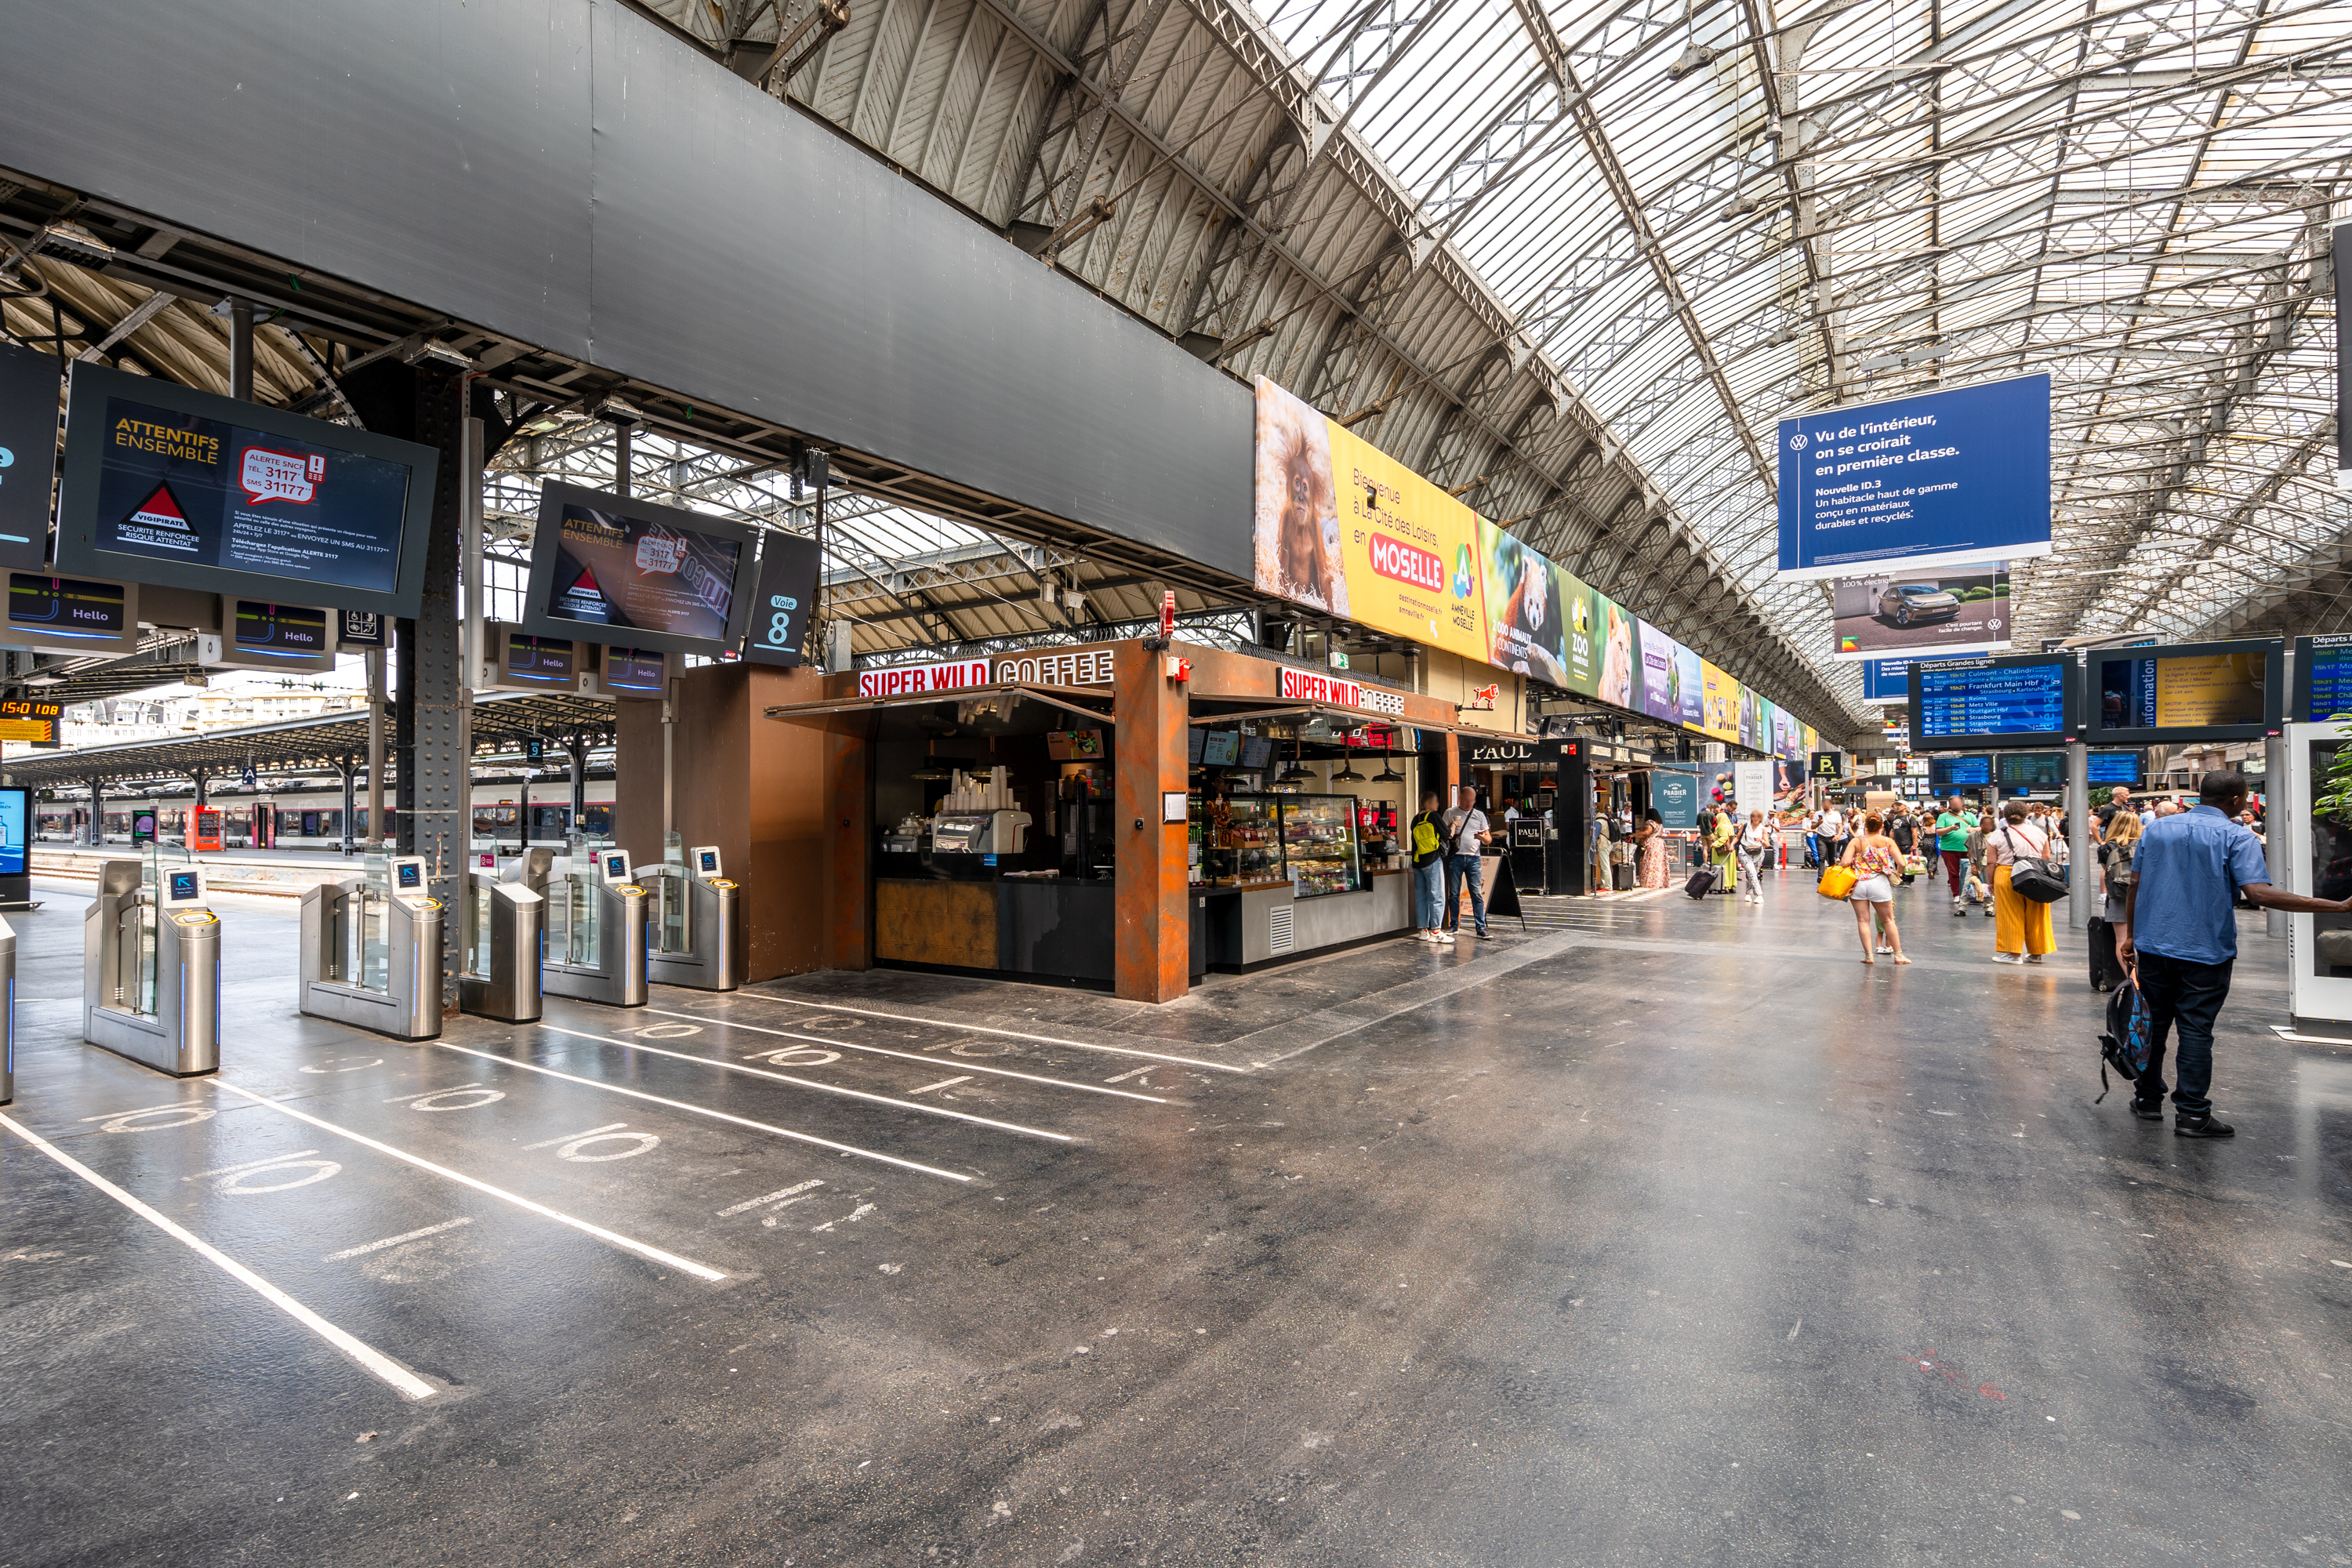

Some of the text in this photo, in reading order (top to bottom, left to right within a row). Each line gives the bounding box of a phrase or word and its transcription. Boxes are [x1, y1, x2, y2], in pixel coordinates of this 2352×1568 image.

[116, 418, 220, 450] ATTENTIFS
[1816, 415, 1936, 442] Vu de l'intérieur,
[116, 432, 218, 464] ENSEMBLE
[1816, 435, 1911, 459] on se croirait
[248, 465, 263, 474] TÉL.
[249, 454, 304, 470] ALERTE SNCF
[1816, 447, 1960, 476] en première classe.
[1816, 480, 1882, 496] Nouvelle ID.3
[1816, 481, 1958, 508] Un habitacle haut de gamme
[1816, 510, 1842, 521] conçu
[1860, 500, 1910, 513] matériaux
[138, 514, 183, 527] VIGIPIRATE
[564, 518, 624, 538] ATTENTIFS
[1353, 495, 1439, 549] à La Cité des Loisirs,
[1816, 518, 1856, 530] durables
[1858, 516, 1868, 525] et
[118, 524, 199, 543] SECURITE RENFORCEE
[125, 532, 191, 547] RISQUE ATTENTAT
[234, 522, 263, 532] APPELEZ
[298, 533, 329, 544] ENVOYEZ
[563, 530, 622, 549] ENSEMBLE
[232, 538, 267, 547] Téléchargez
[268, 543, 301, 554] l'application
[1355, 529, 1441, 589] en MOSELLE
[559, 596, 607, 608] SECURITE RENFORCEE
[571, 588, 598, 597] VIGIPIRATE
[775, 597, 793, 608] Voie
[1399, 593, 1443, 616] destinationmoselle.fr
[1451, 602, 1475, 619] AMNÉVILLE
[73, 608, 108, 622] Hello
[1399, 606, 1424, 621] amneville.fr
[768, 612, 789, 644] 8
[1453, 616, 1473, 632] MOSELLE
[1493, 619, 1532, 646] 2 000 ANIMAUX
[285, 632, 313, 643] Hello
[1573, 633, 1588, 657] ZOO
[1493, 636, 1528, 659] 5 CONTINENTS
[543, 659, 563, 668] Hello
[861, 649, 1113, 697] SUPER WILD COFFEE
[1284, 670, 1405, 717] SUPER WILD COFFEE
[2040, 674, 2059, 731] départs
[2142, 660, 2154, 727] information
[532, 746, 538, 756] 9
[1472, 745, 1532, 760] PAUL
[245, 769, 254, 778] A
